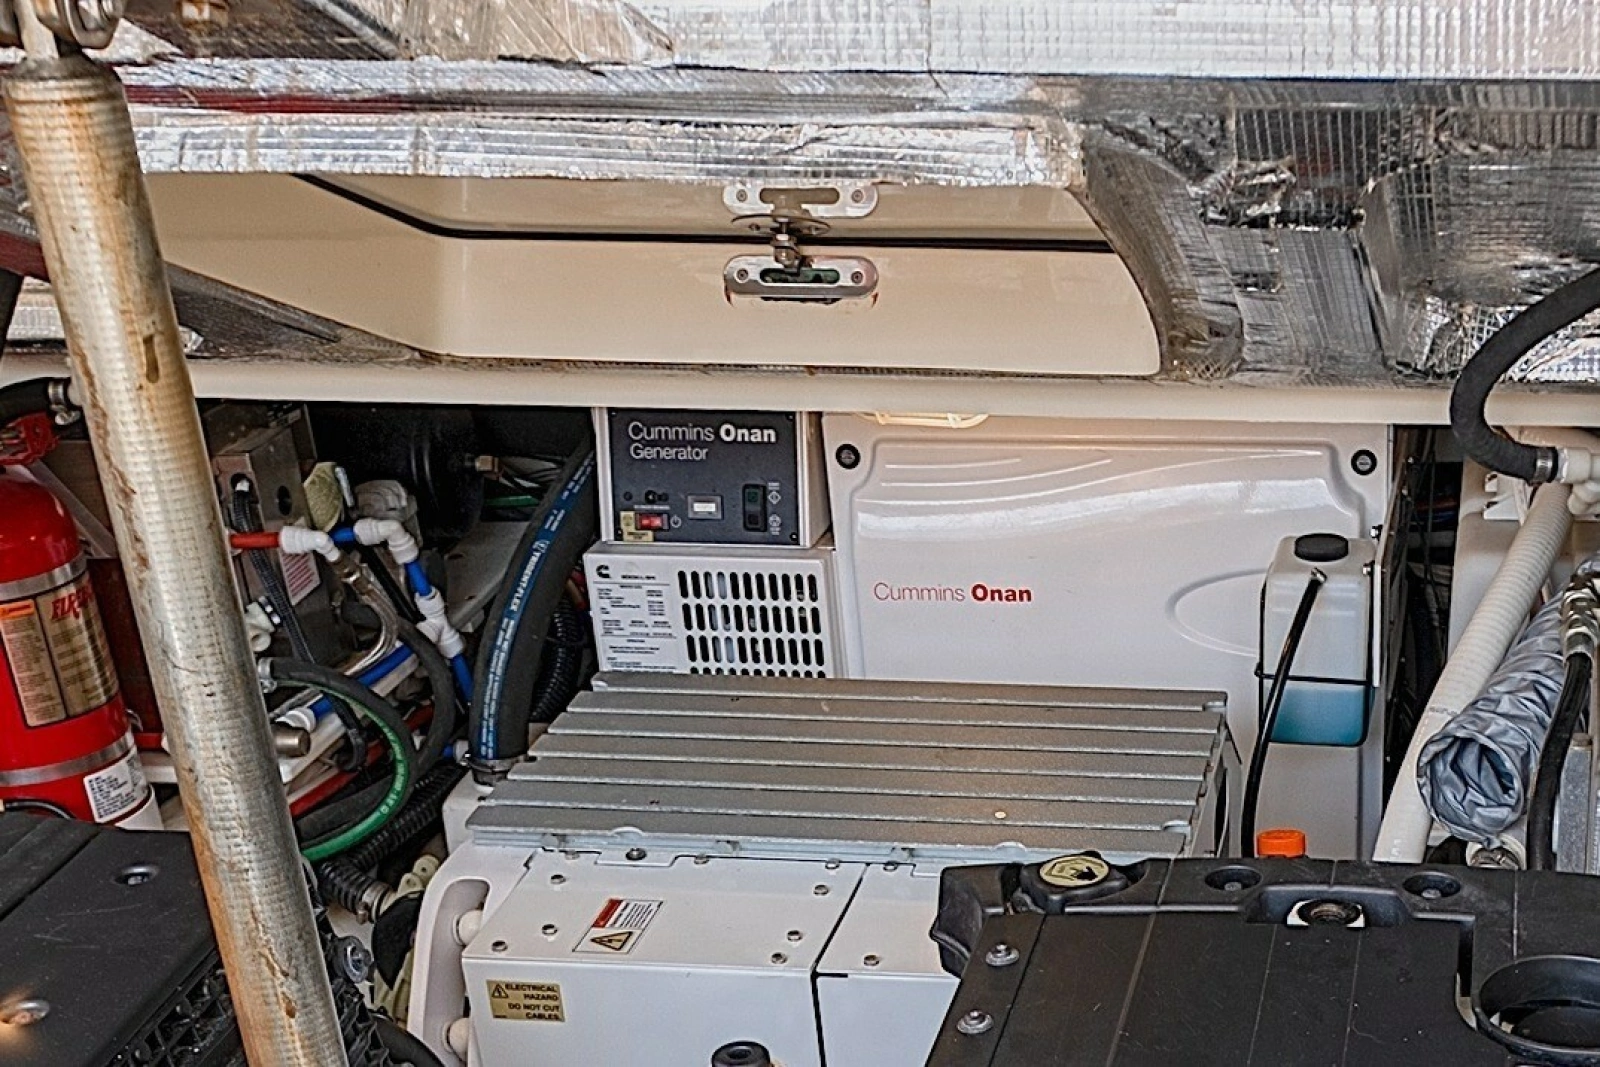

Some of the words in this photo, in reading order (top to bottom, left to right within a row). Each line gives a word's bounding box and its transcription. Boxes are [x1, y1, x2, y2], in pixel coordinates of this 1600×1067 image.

[628, 421, 715, 442] Cummins
[719, 424, 777, 443] Onan
[629, 443, 709, 460] Generator
[874, 582, 966, 601] Cummins
[971, 584, 1032, 602] Onan
[505, 983, 557, 992] ELECTRICAL
[508, 1002, 521, 1010] DO
[523, 1003, 541, 1011] NOT
[543, 1004, 560, 1012] CUT
